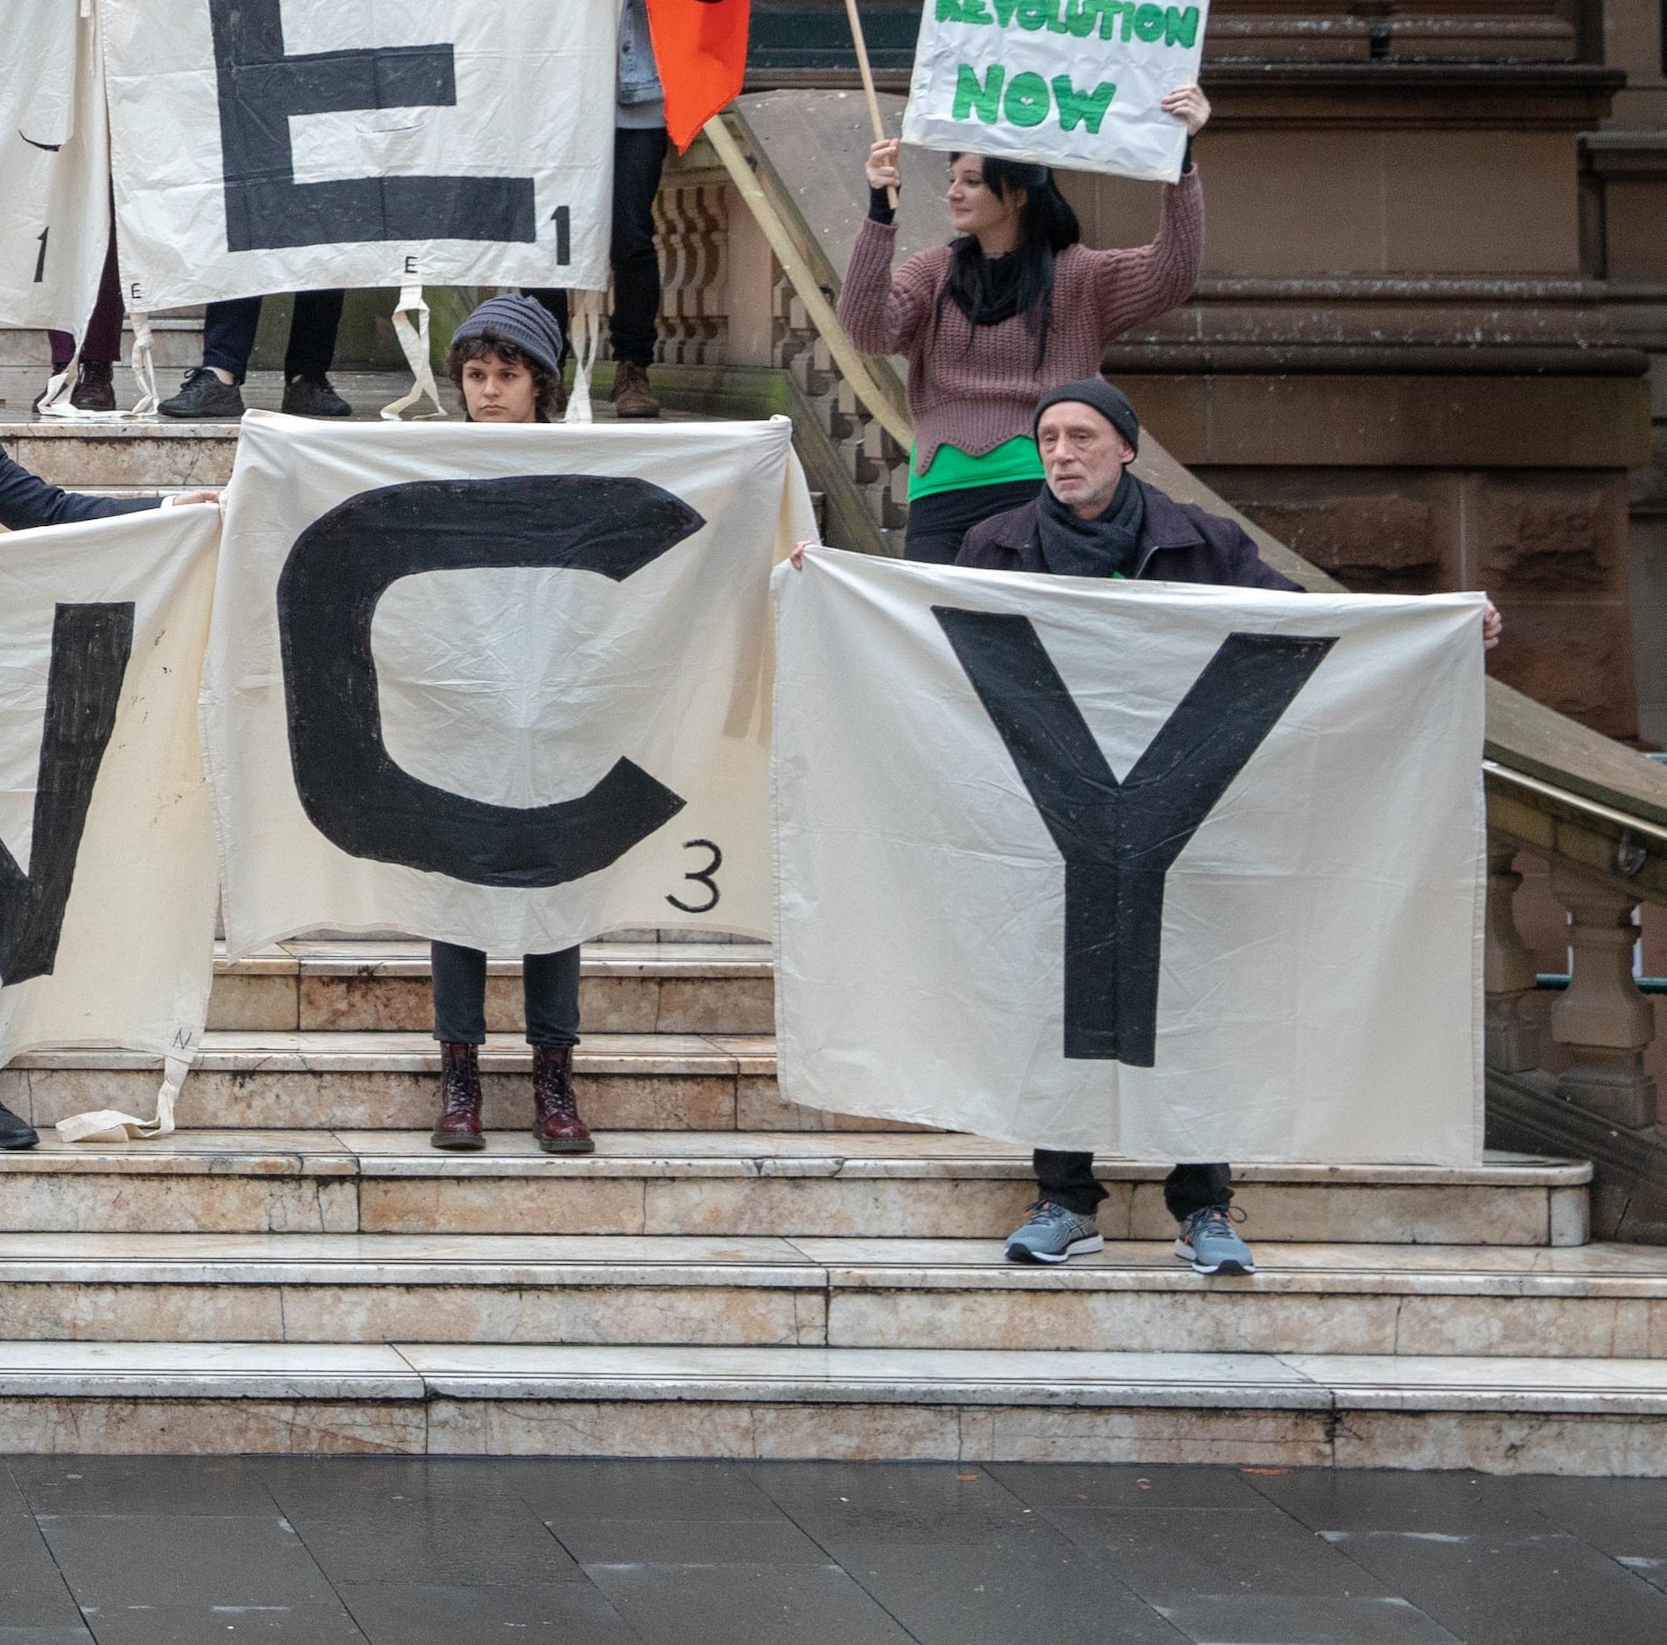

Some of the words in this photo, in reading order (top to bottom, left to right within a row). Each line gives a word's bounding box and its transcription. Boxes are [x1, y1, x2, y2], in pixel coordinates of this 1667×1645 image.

[952, 63, 1117, 135] NOW
[33, 226, 50, 284] 1
[404, 255, 419, 274] E
[550, 205, 572, 266] 1
[130, 282, 143, 300] E
[664, 838, 724, 915] 3
